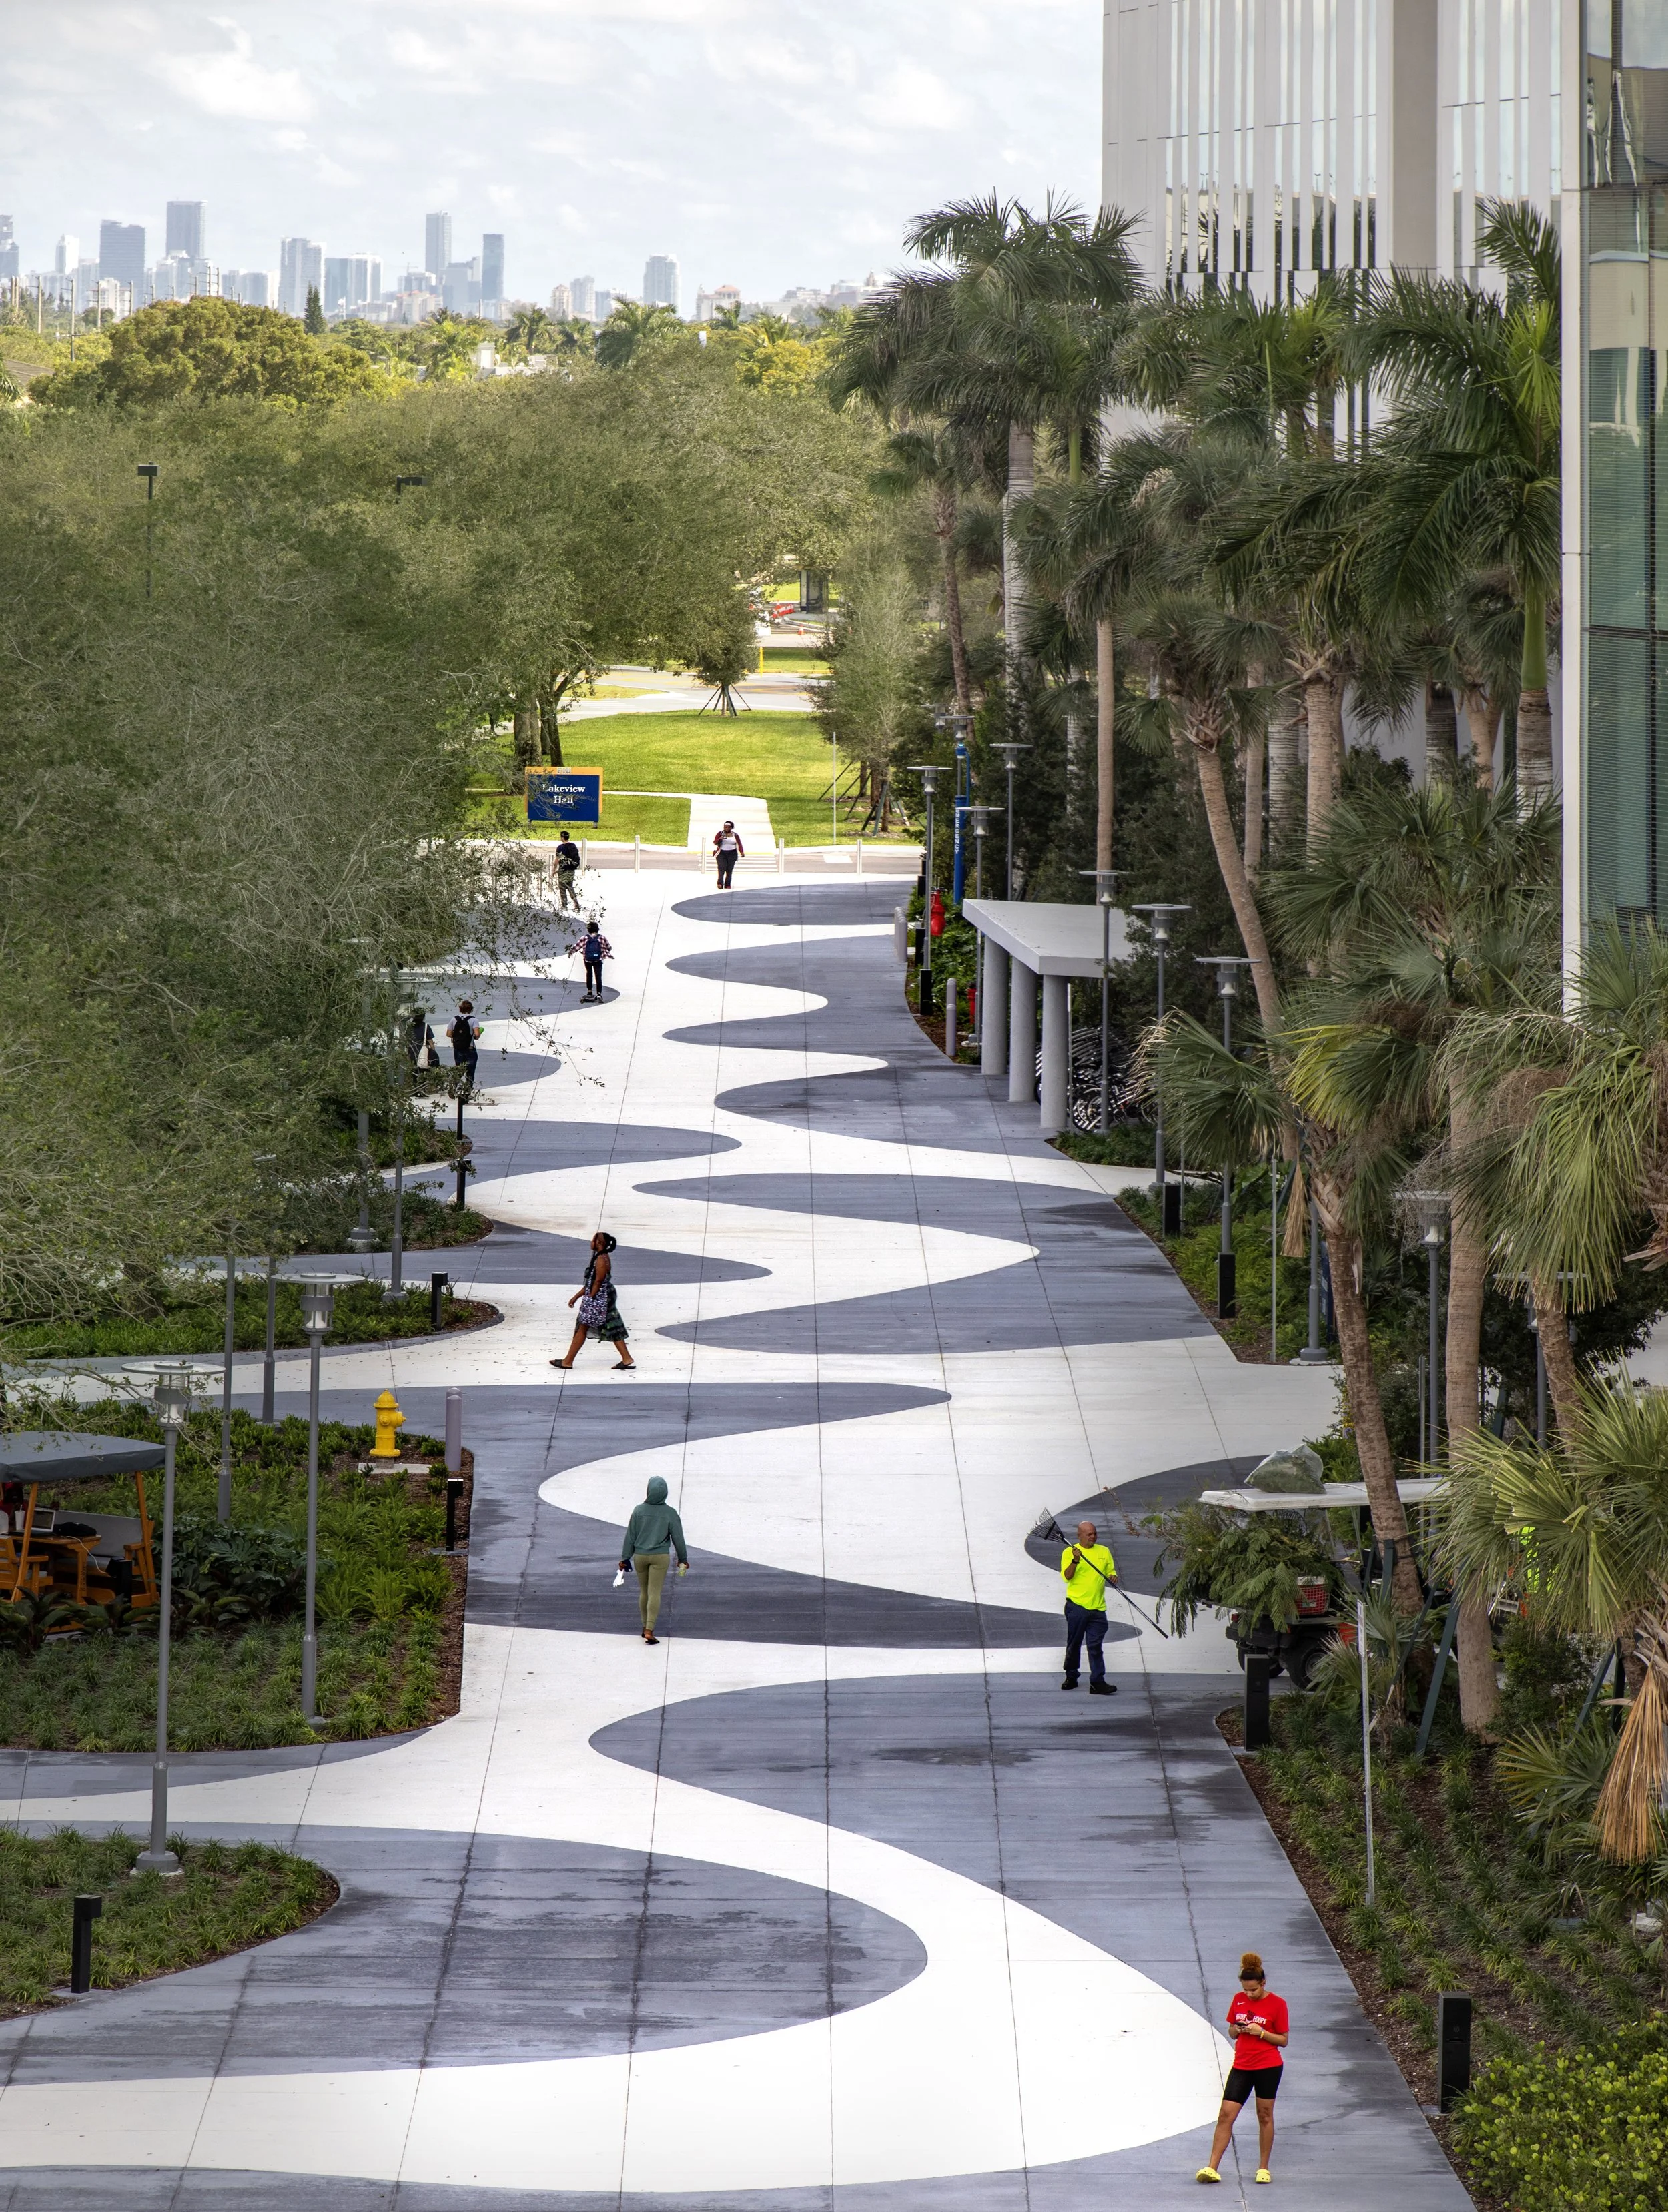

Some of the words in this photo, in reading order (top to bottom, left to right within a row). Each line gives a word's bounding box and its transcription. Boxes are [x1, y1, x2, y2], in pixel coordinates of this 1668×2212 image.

[542, 784, 586, 793] Lakeview
[554, 795, 573, 803] Hall
[1252, 2016, 1267, 2025] HOOPS
